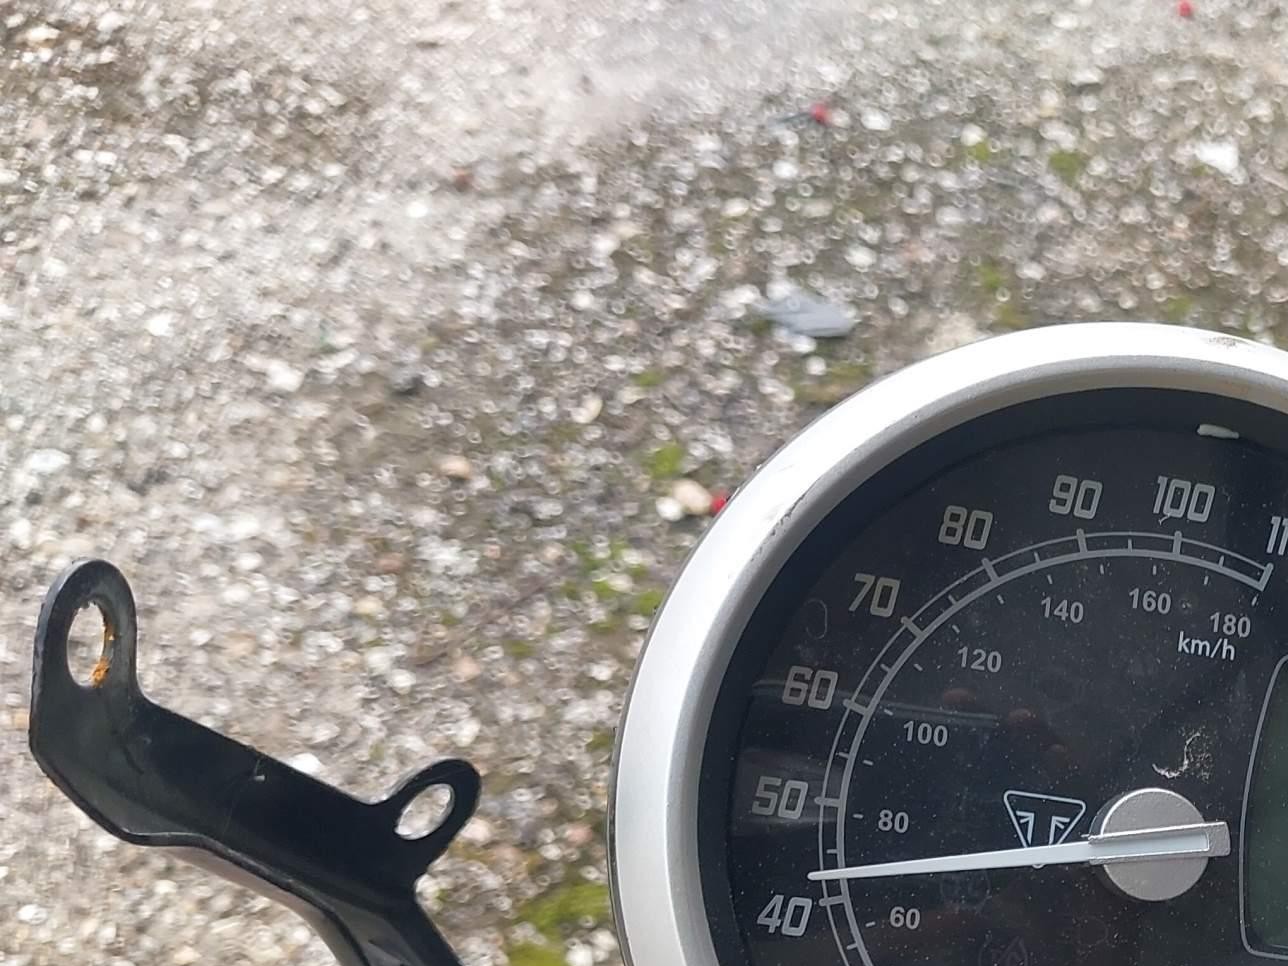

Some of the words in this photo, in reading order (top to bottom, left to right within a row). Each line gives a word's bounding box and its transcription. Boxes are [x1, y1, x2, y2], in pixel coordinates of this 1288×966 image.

[1049, 474, 1102, 520] 90
[1153, 475, 1216, 523] 100
[938, 505, 993, 550] 80
[848, 573, 900, 618] 70
[1040, 598, 1085, 624] 140
[1128, 588, 1172, 614] 160
[1209, 612, 1252, 638] 180
[956, 646, 1002, 674] 120
[1177, 631, 1237, 662] km/h
[781, 665, 838, 710] 60
[902, 720, 949, 747] 100
[752, 776, 809, 820] 50
[878, 810, 910, 834] 80
[756, 894, 813, 937] 40
[888, 906, 921, 930] 60
